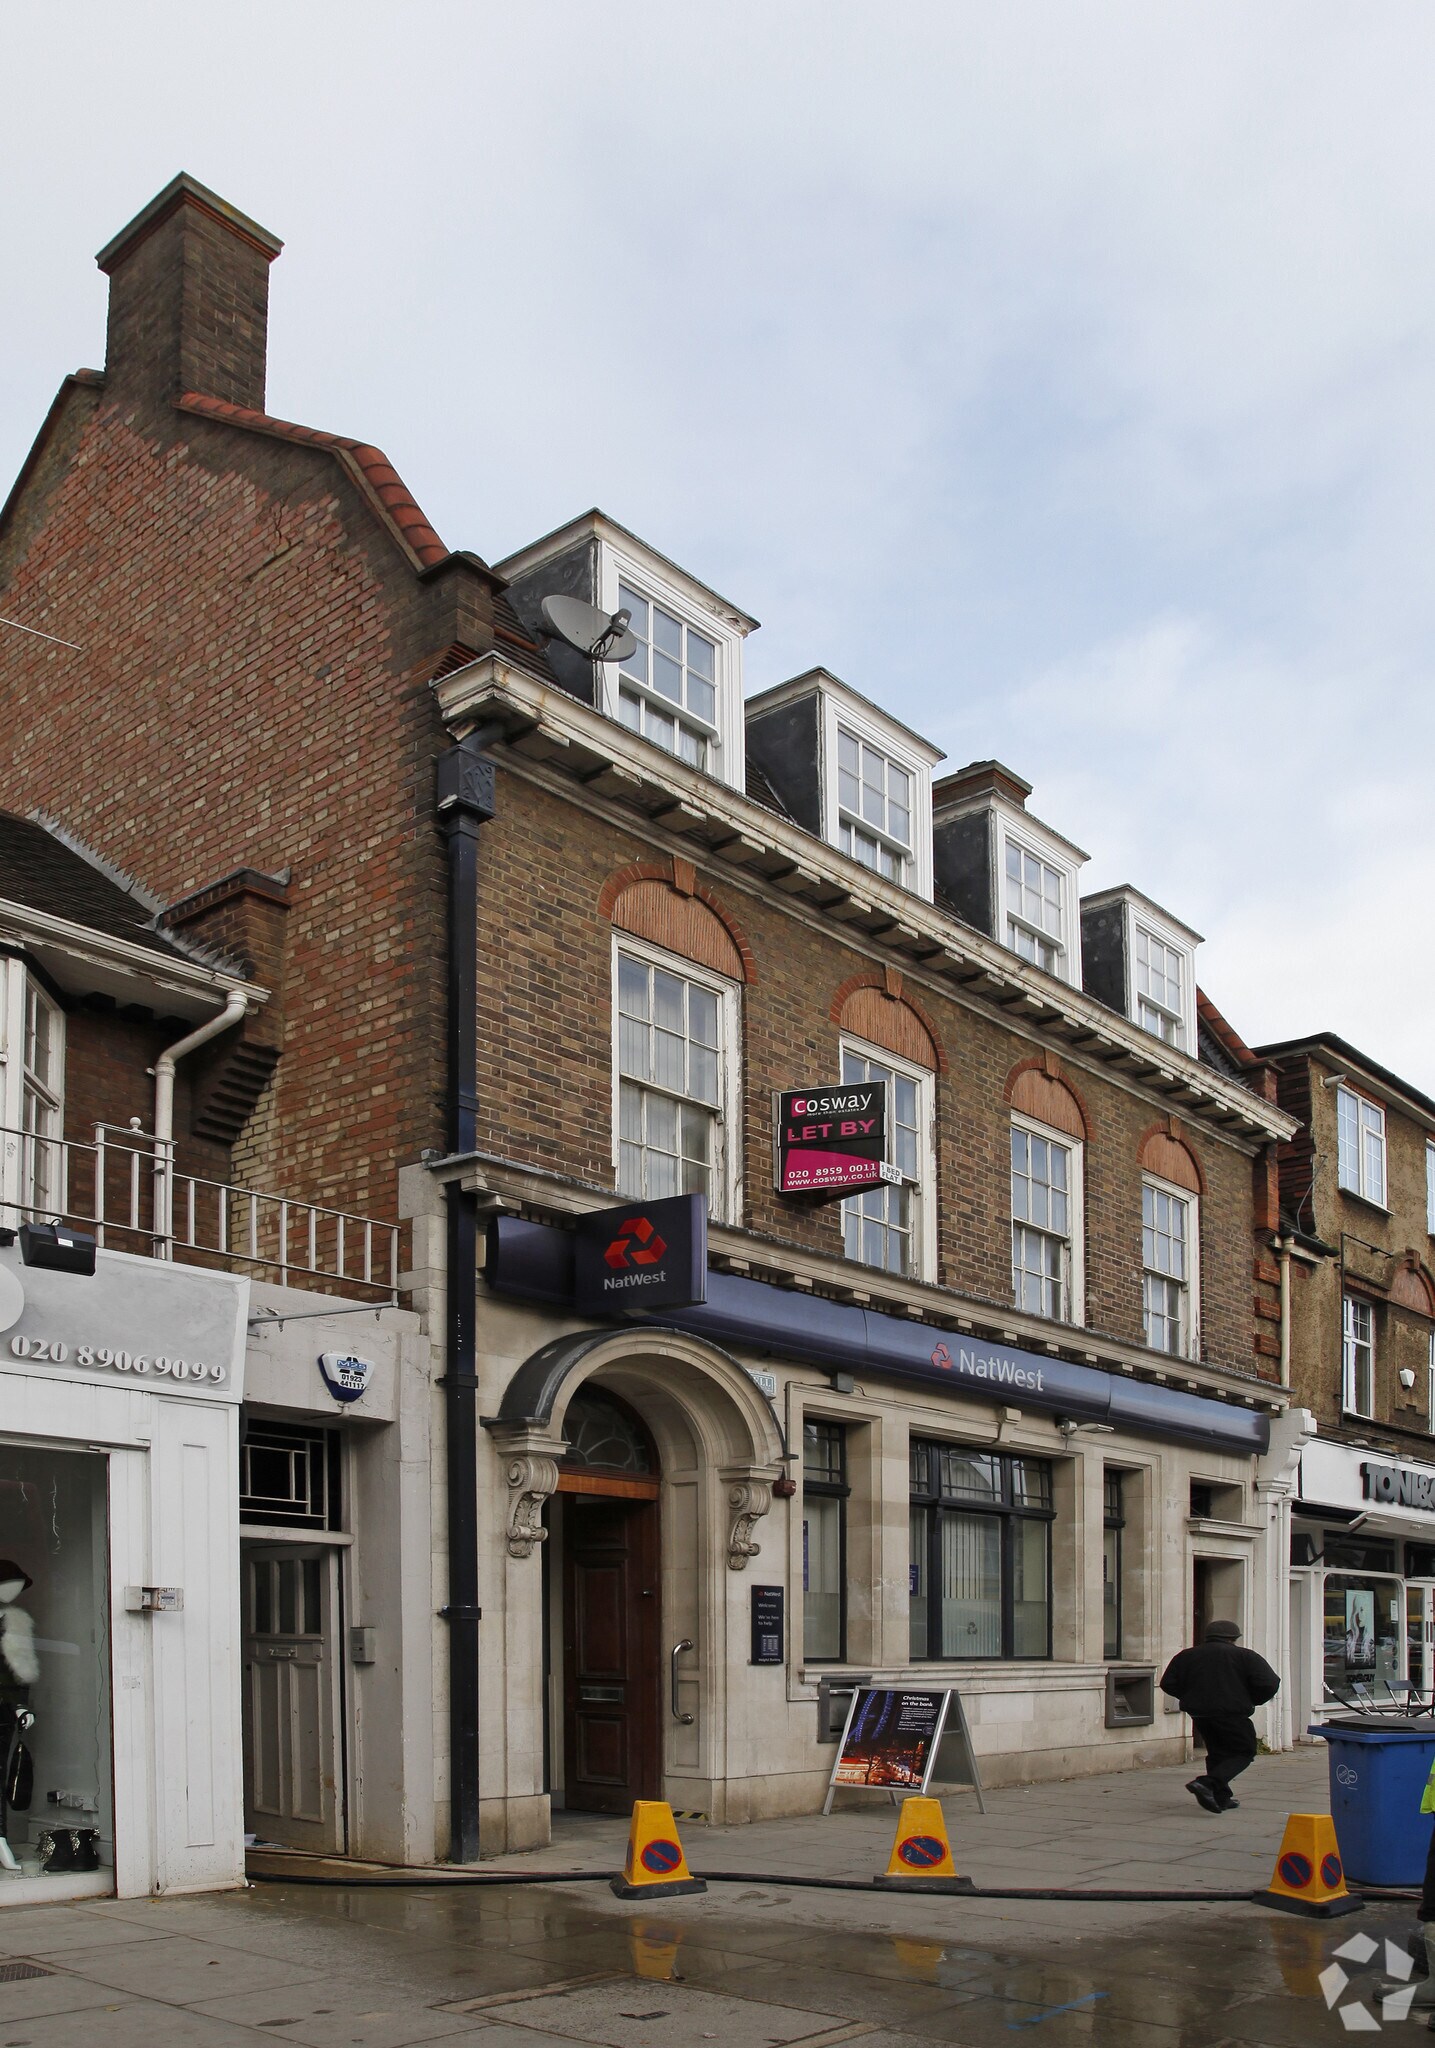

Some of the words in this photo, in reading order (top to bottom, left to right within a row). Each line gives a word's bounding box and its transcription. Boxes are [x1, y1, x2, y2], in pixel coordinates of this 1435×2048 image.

[787, 1123, 833, 1142] LET
[841, 1119, 876, 1136] BY
[787, 1171, 878, 1187] www.cosway.co.uk
[788, 1170, 809, 1179] 020
[815, 1167, 842, 1176] 8959
[849, 1163, 876, 1173] 0011
[882, 1171, 898, 1182] FLAT
[887, 1166, 900, 1176] BED
[604, 1270, 667, 1290] NatWest
[11, 1335, 69, 1362] 020
[337, 1360, 366, 1370] M25
[959, 1348, 1044, 1391] NatWest
[340, 1380, 364, 1389] 441117
[341, 1373, 363, 1383] 01923
